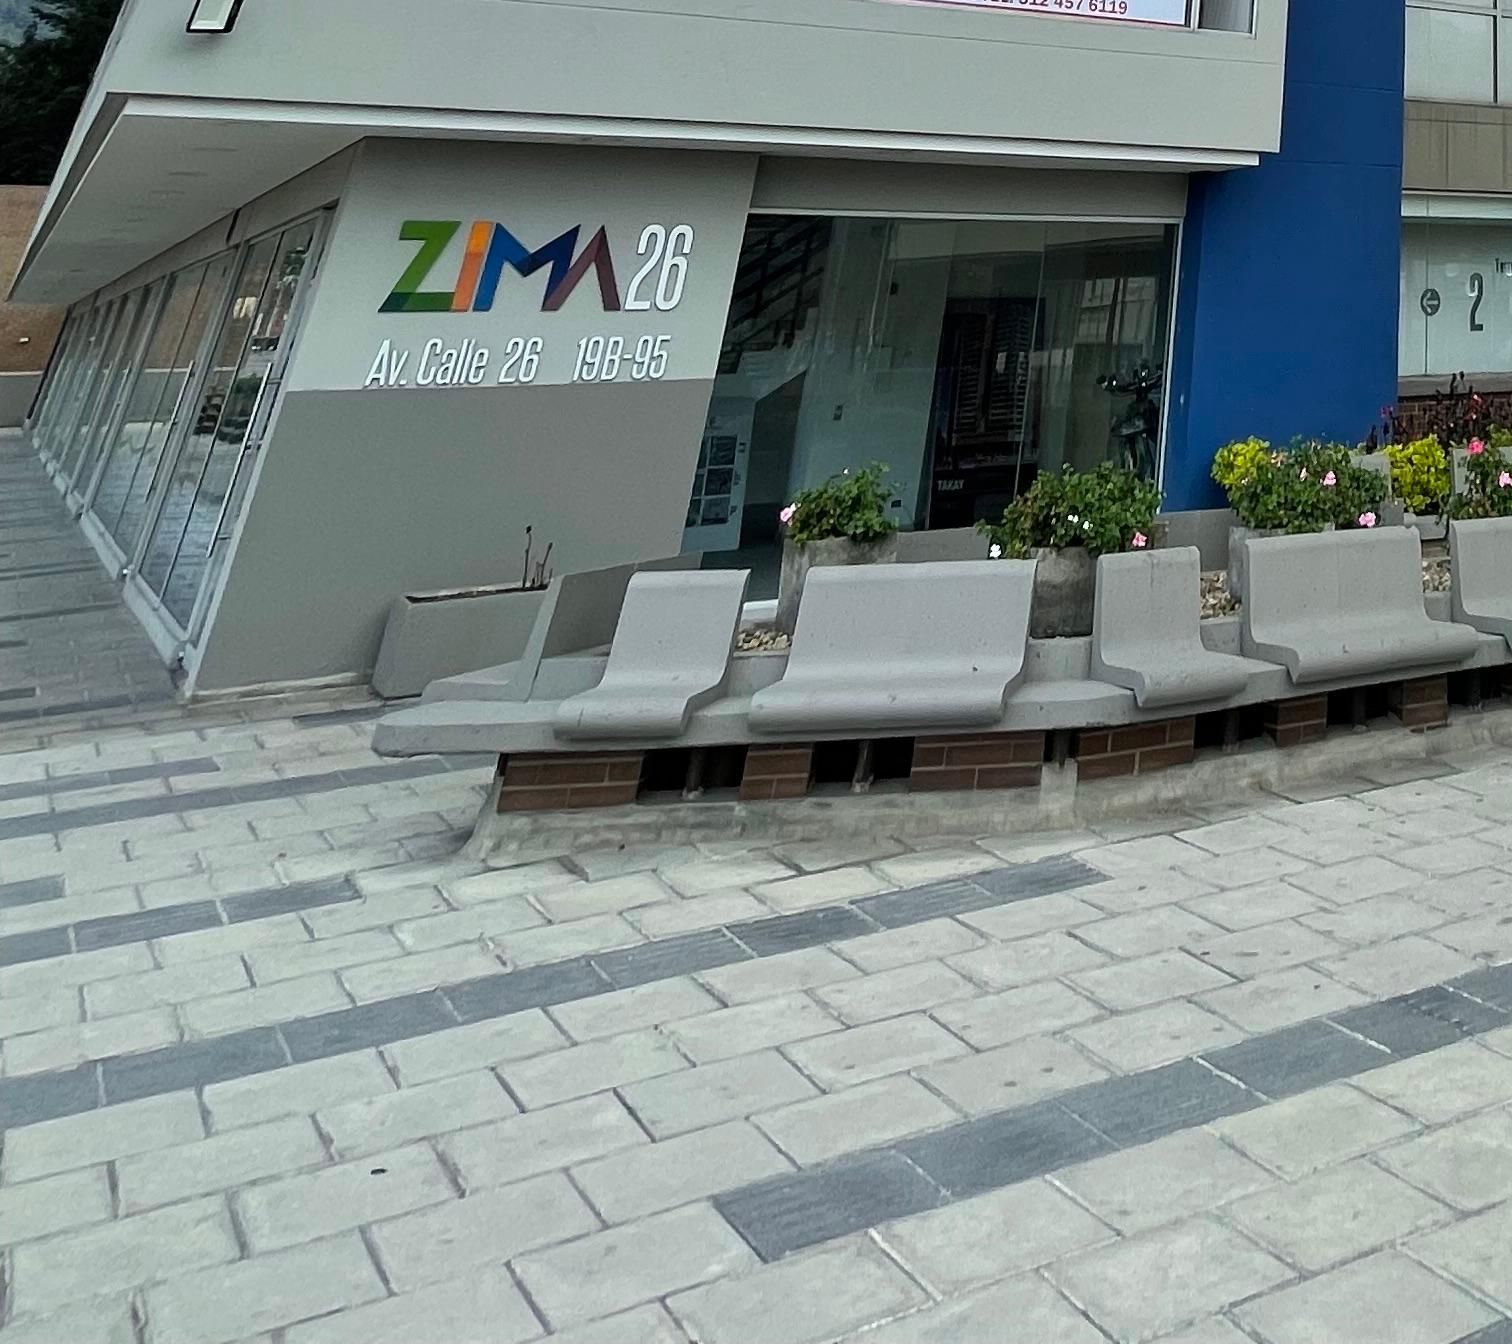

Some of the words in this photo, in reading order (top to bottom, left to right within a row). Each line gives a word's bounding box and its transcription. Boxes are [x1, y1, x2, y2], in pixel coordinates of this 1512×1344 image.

[378, 220, 621, 312] ZIMA
[623, 223, 695, 311] 26
[1469, 272, 1483, 331] 2
[365, 338, 410, 388] Av.
[416, 337, 490, 385] Calle
[498, 336, 544, 383] 26
[571, 335, 672, 382] 19B-95
